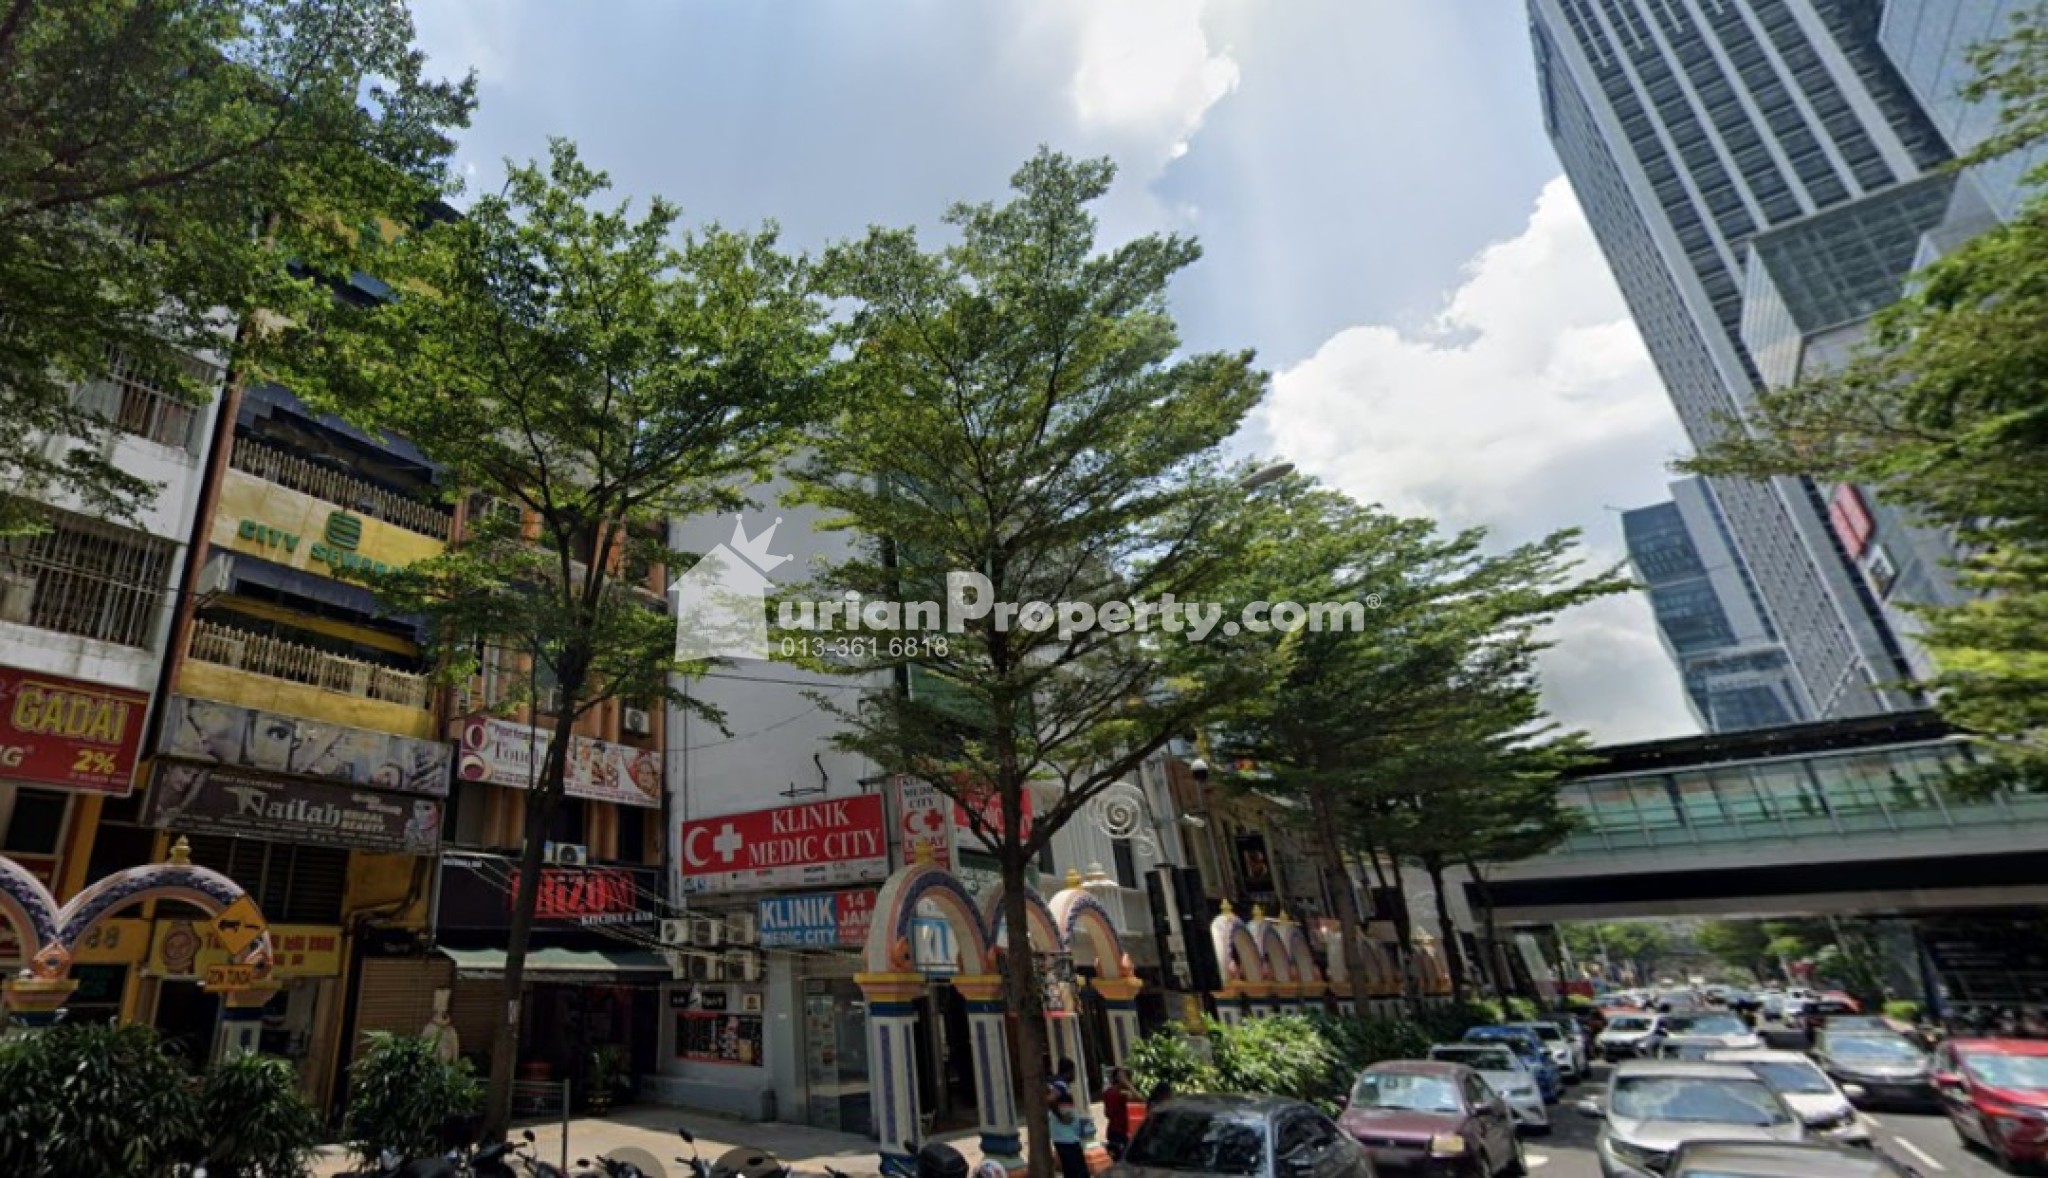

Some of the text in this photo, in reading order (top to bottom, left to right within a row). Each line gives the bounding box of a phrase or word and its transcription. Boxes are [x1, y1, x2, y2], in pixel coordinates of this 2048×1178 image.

[238, 518, 299, 552] CITY
[12, 688, 130, 744] GADAI
[72, 748, 117, 775] 2%
[771, 802, 850, 834] KLINIK
[748, 835, 818, 866] MEDIC
[823, 828, 881, 859] CITY
[761, 896, 837, 930] KLINIK
[847, 892, 867, 909] 14
[805, 927, 836, 944] CITY
